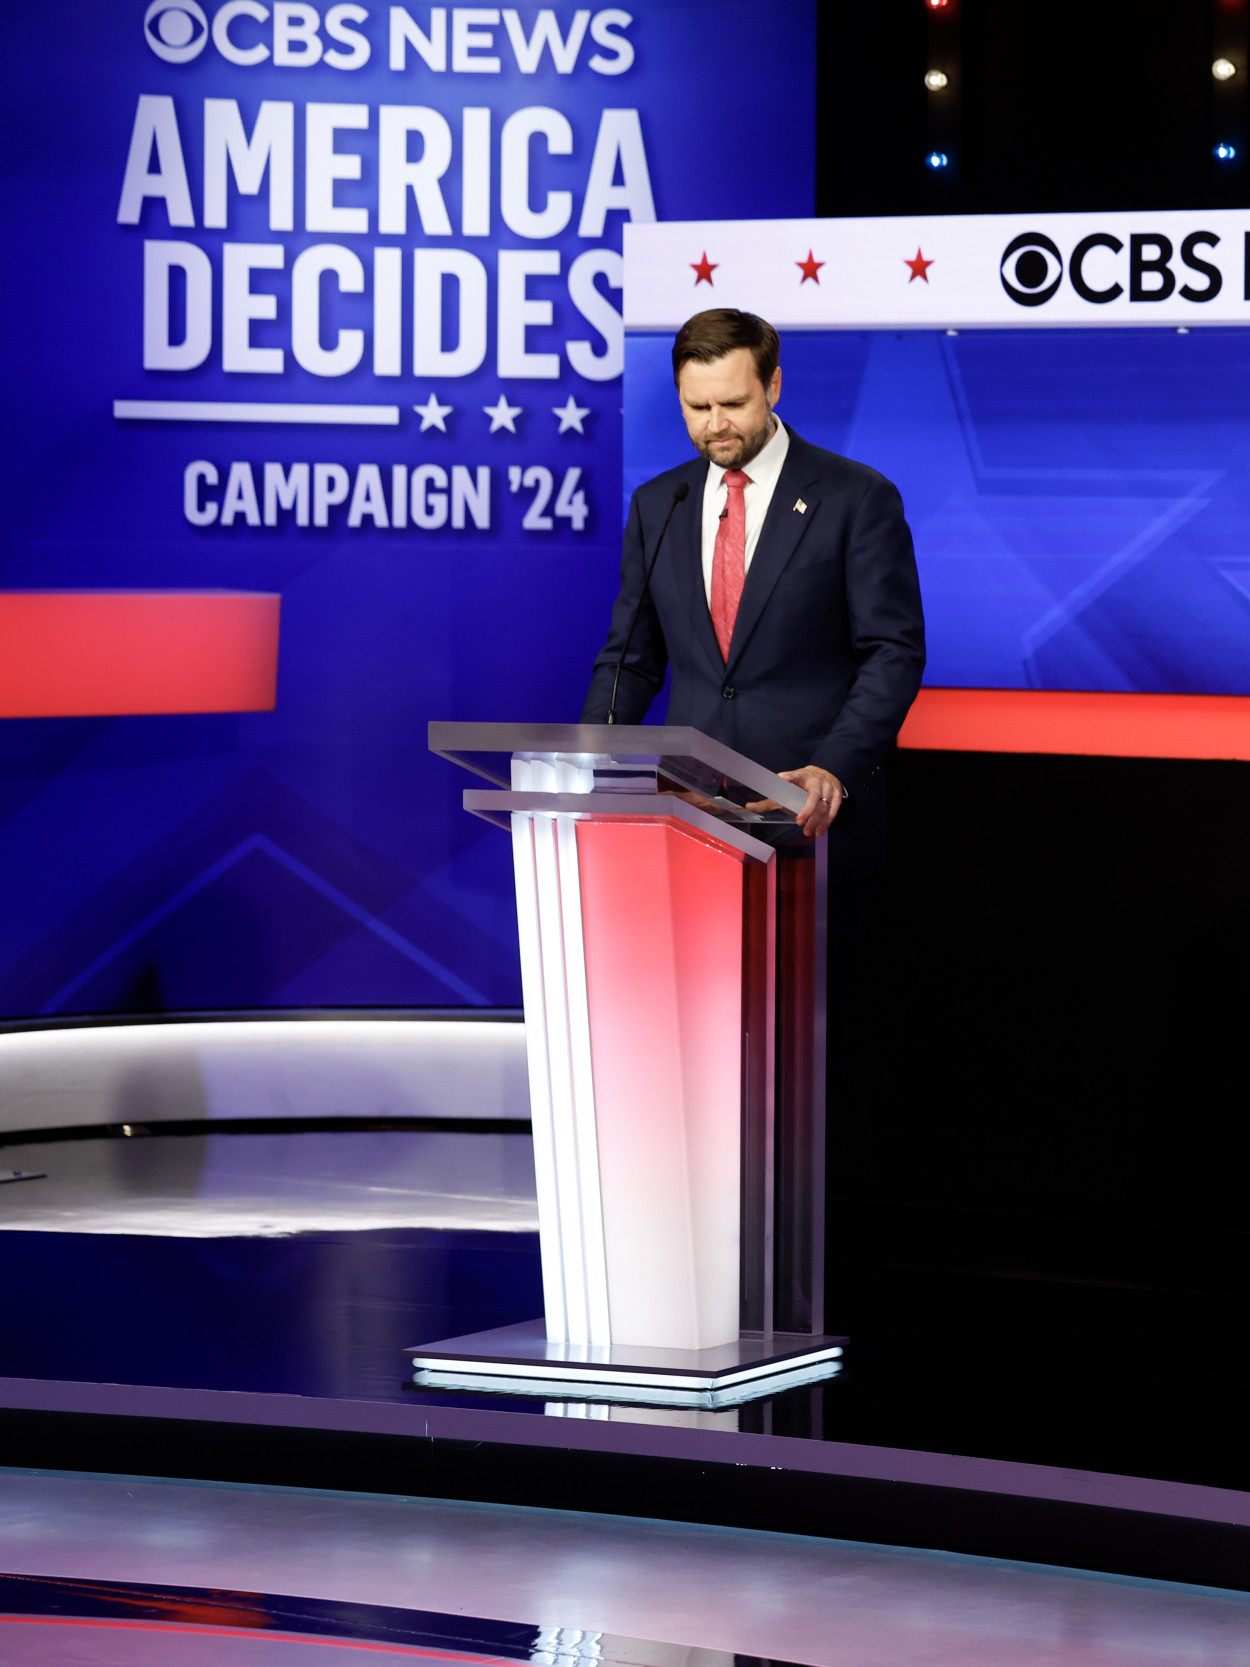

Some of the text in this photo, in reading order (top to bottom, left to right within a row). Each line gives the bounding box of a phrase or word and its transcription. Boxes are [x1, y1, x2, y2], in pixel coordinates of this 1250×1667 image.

[212, 0, 635, 76] CBS NEWS
[117, 94, 656, 240] AMERICA
[1068, 230, 1223, 304] CBS
[143, 239, 623, 381] DECIDES
[184, 460, 491, 530] CAMPAIGN
